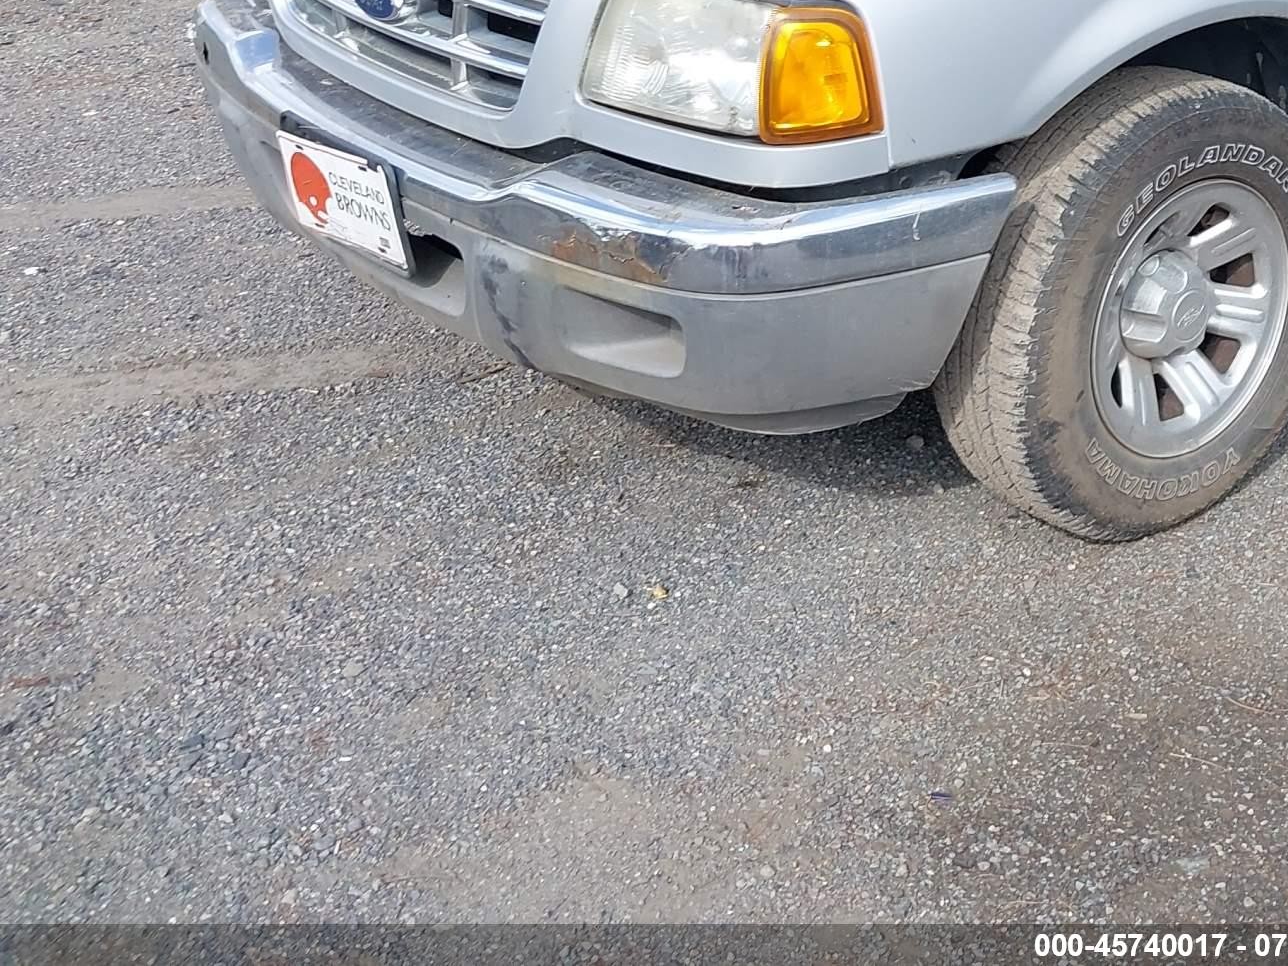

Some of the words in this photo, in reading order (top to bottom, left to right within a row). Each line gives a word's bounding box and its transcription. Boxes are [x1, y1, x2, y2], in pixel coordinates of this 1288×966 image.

[328, 171, 385, 204] CLEVELAND
[335, 191, 392, 232] BROWNS
[1085, 436, 1241, 500] YOKOHAMA
